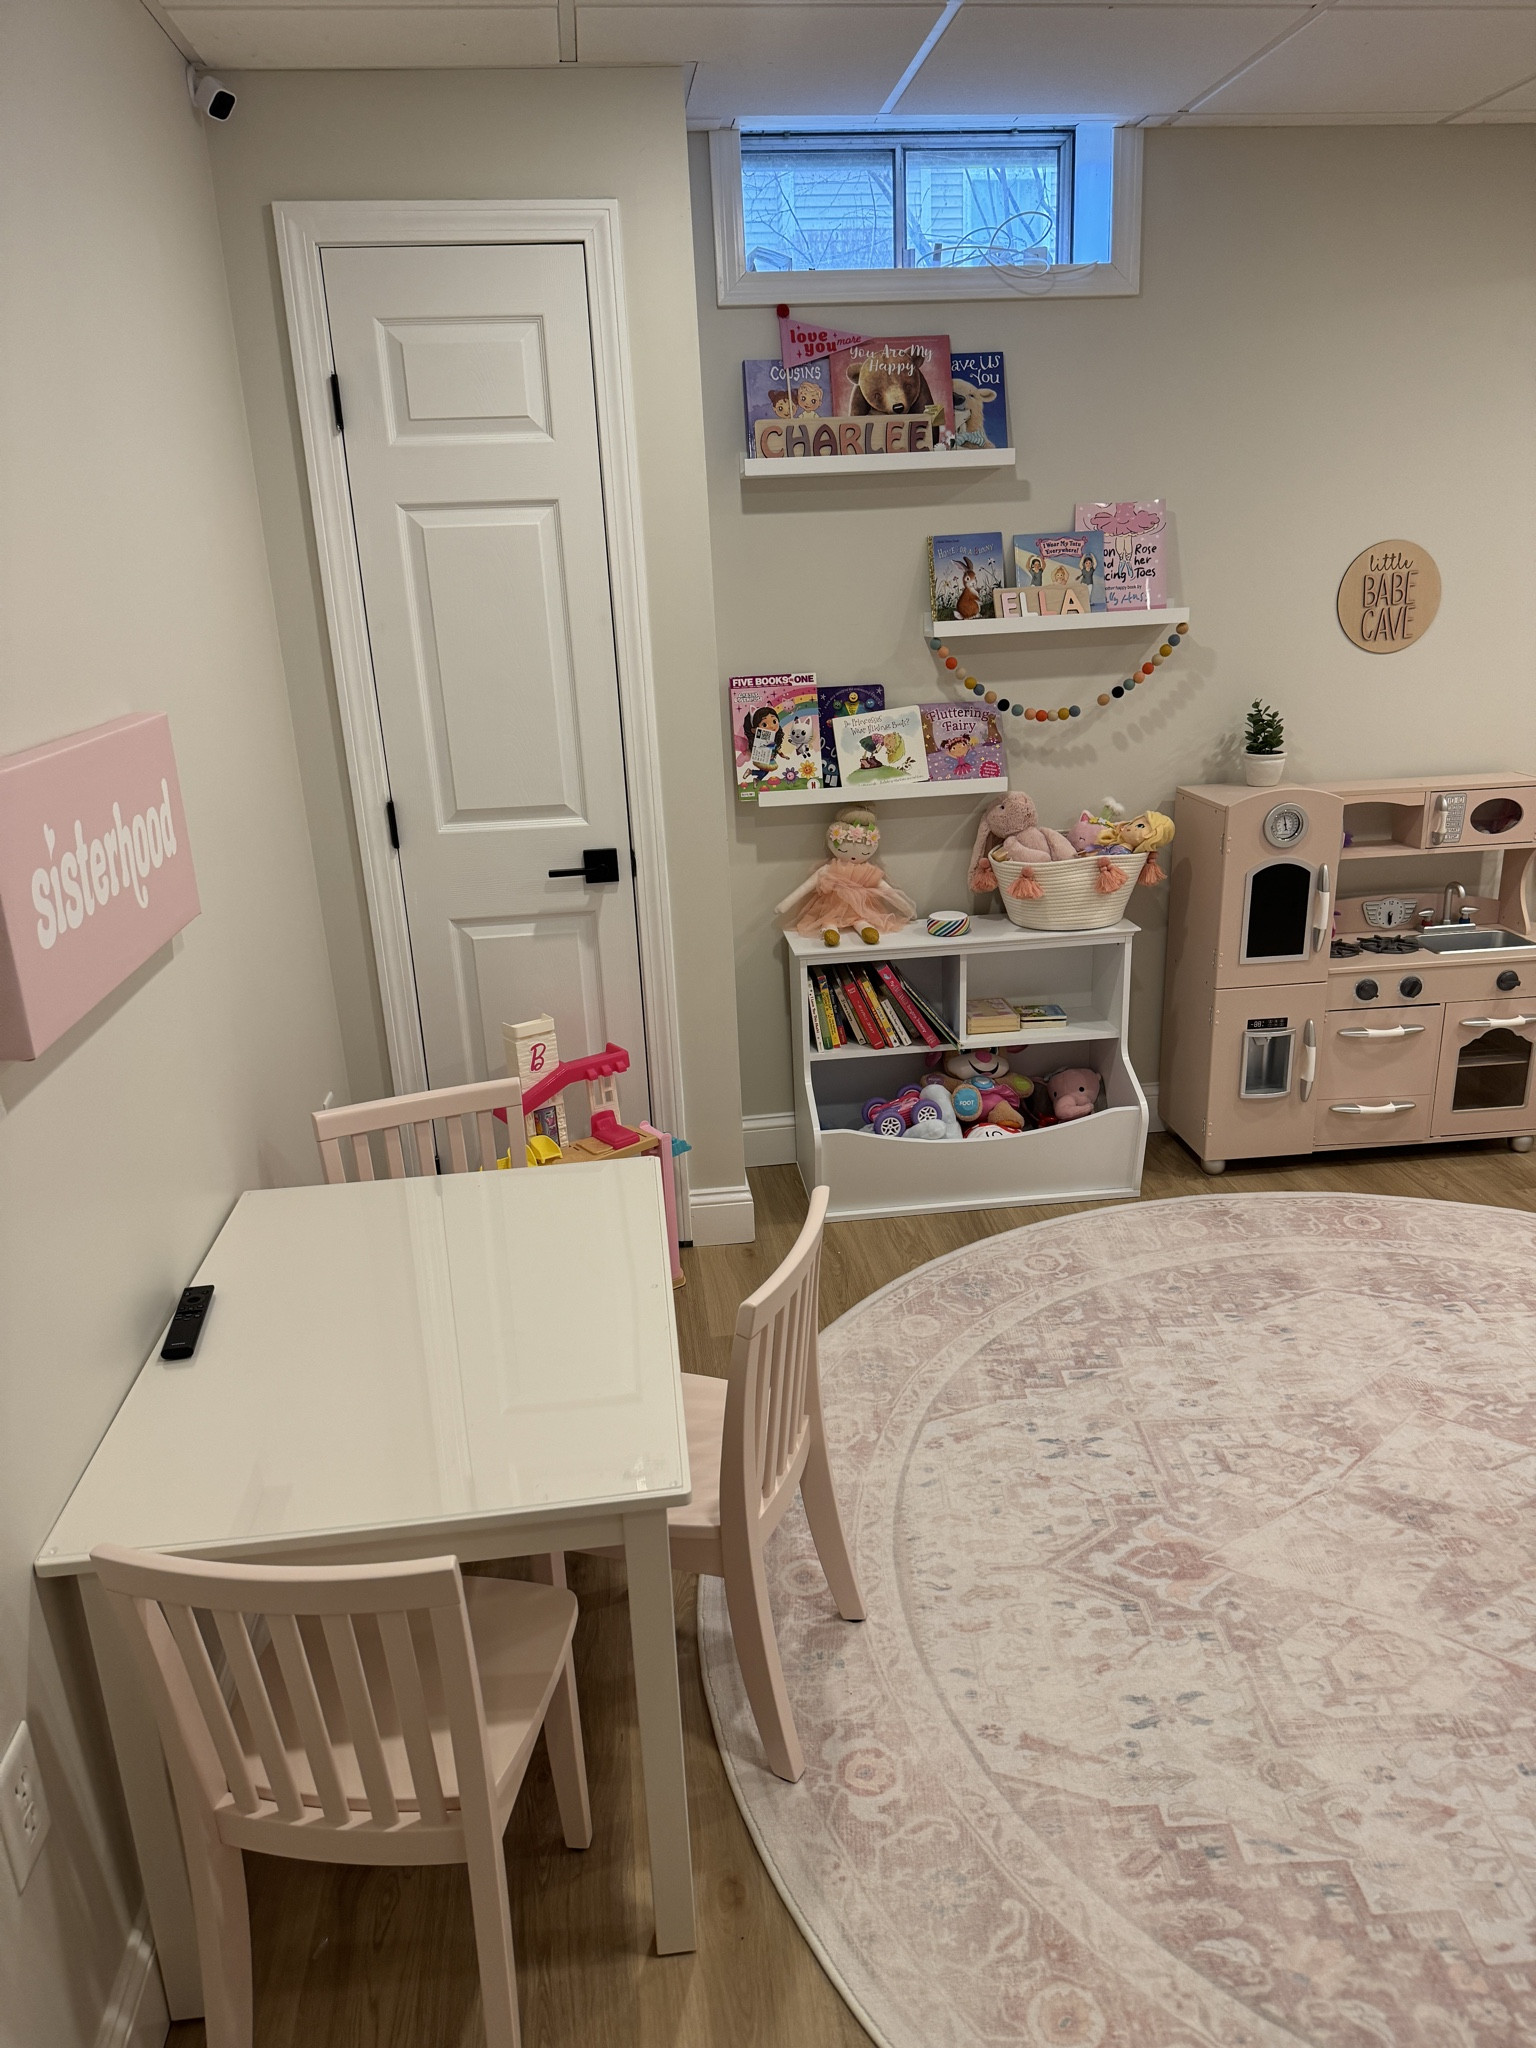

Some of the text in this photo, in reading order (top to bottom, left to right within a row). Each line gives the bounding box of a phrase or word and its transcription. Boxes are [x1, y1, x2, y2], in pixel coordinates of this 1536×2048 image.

[790, 329, 828, 343] love
[804, 336, 862, 357] you more
[849, 344, 933, 362] You Are My
[869, 359, 915, 377] Happy
[951, 359, 978, 371] ave
[969, 368, 1000, 386] You
[760, 420, 930, 458] CHARLEE
[1103, 543, 1157, 558] on Rose
[1134, 555, 1152, 566] her
[1370, 552, 1414, 572] little
[1104, 567, 1156, 583] cing Toes
[1362, 570, 1419, 609] BABE
[1000, 589, 1085, 618] ELLA
[1361, 605, 1417, 642] CAVE
[732, 678, 754, 687] FIVE
[755, 676, 789, 686] BOOKS
[794, 674, 814, 684] ONE
[926, 706, 990, 722] Fluttering
[942, 719, 976, 734] Fairy
[31, 777, 177, 950] sisterhood
[529, 1042, 547, 1072] B
